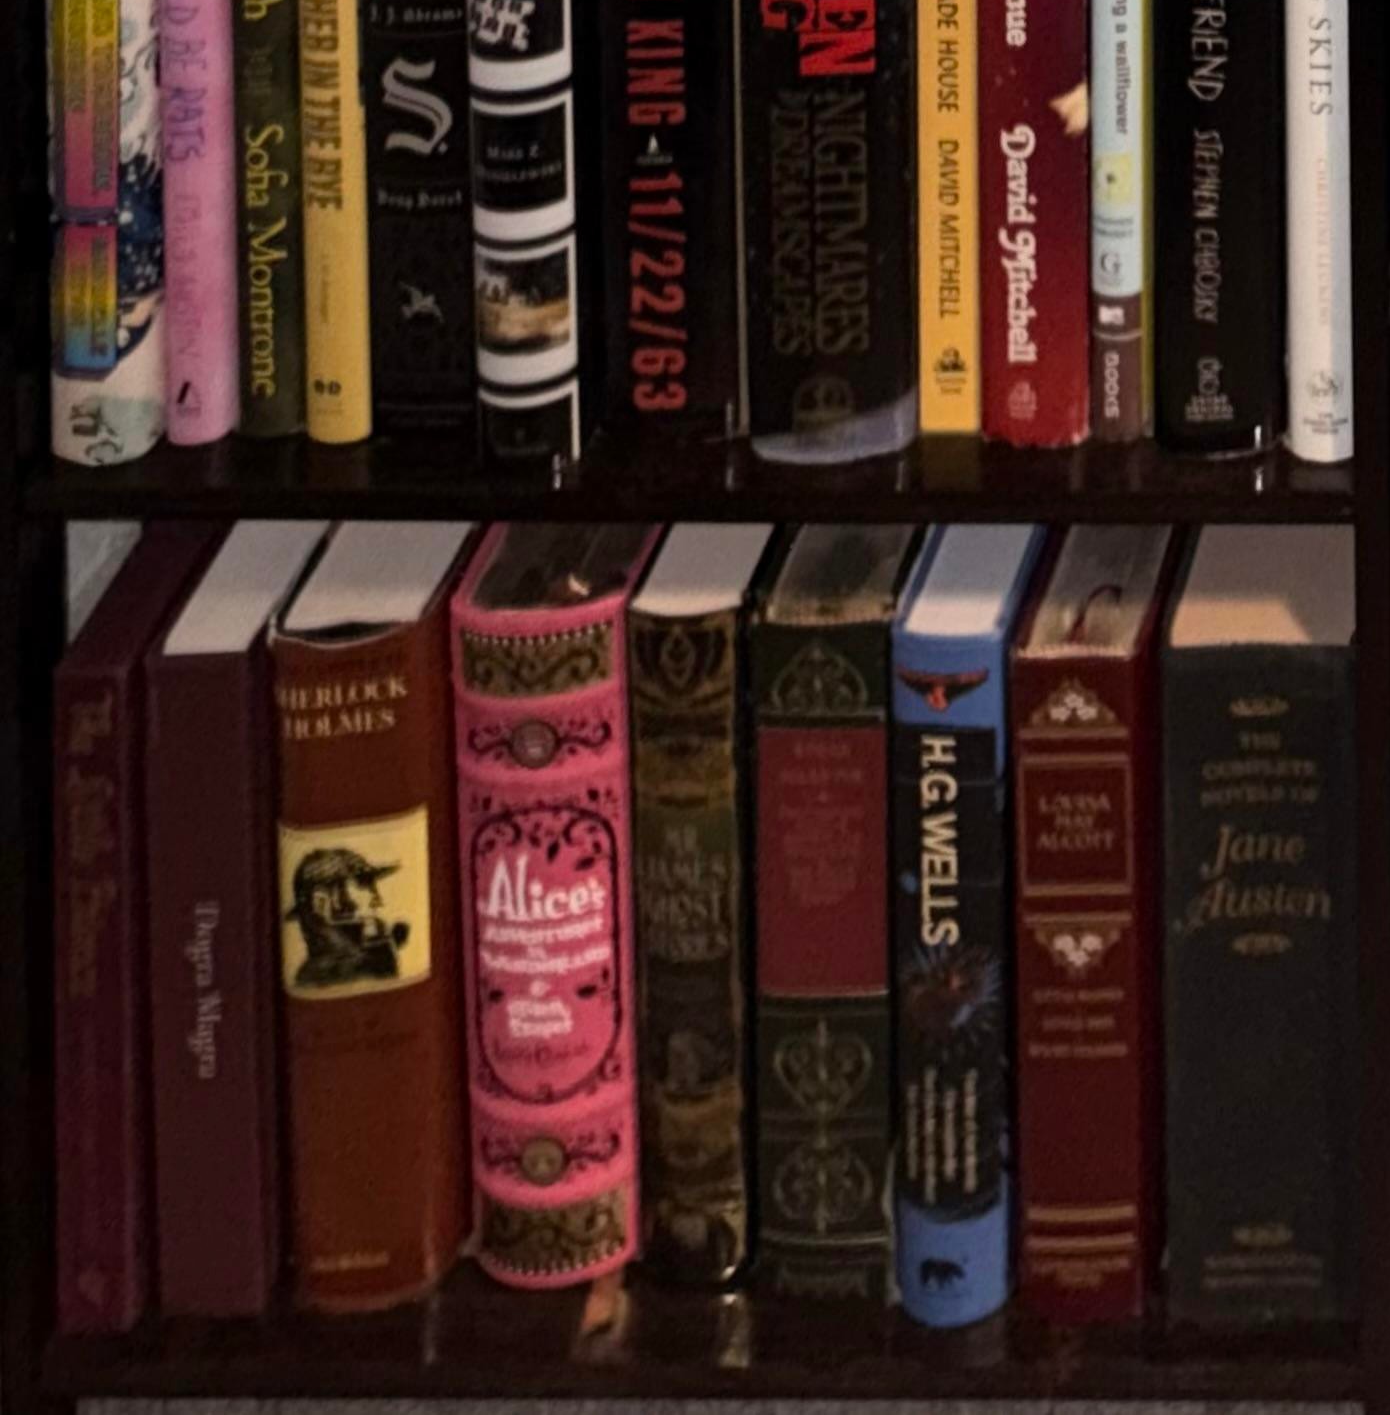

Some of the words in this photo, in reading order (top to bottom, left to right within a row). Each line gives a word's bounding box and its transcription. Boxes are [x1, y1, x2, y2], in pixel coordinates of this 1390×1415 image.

[625, 19, 685, 125] KING
[937, 40, 959, 111] HOUSE
[1309, 16, 1333, 116] SKIES
[628, 173, 686, 411] 11/22/63
[920, 816, 958, 947] WELLS
[1204, 827, 1304, 875] Jane
[1187, 878, 1331, 930] Austen
